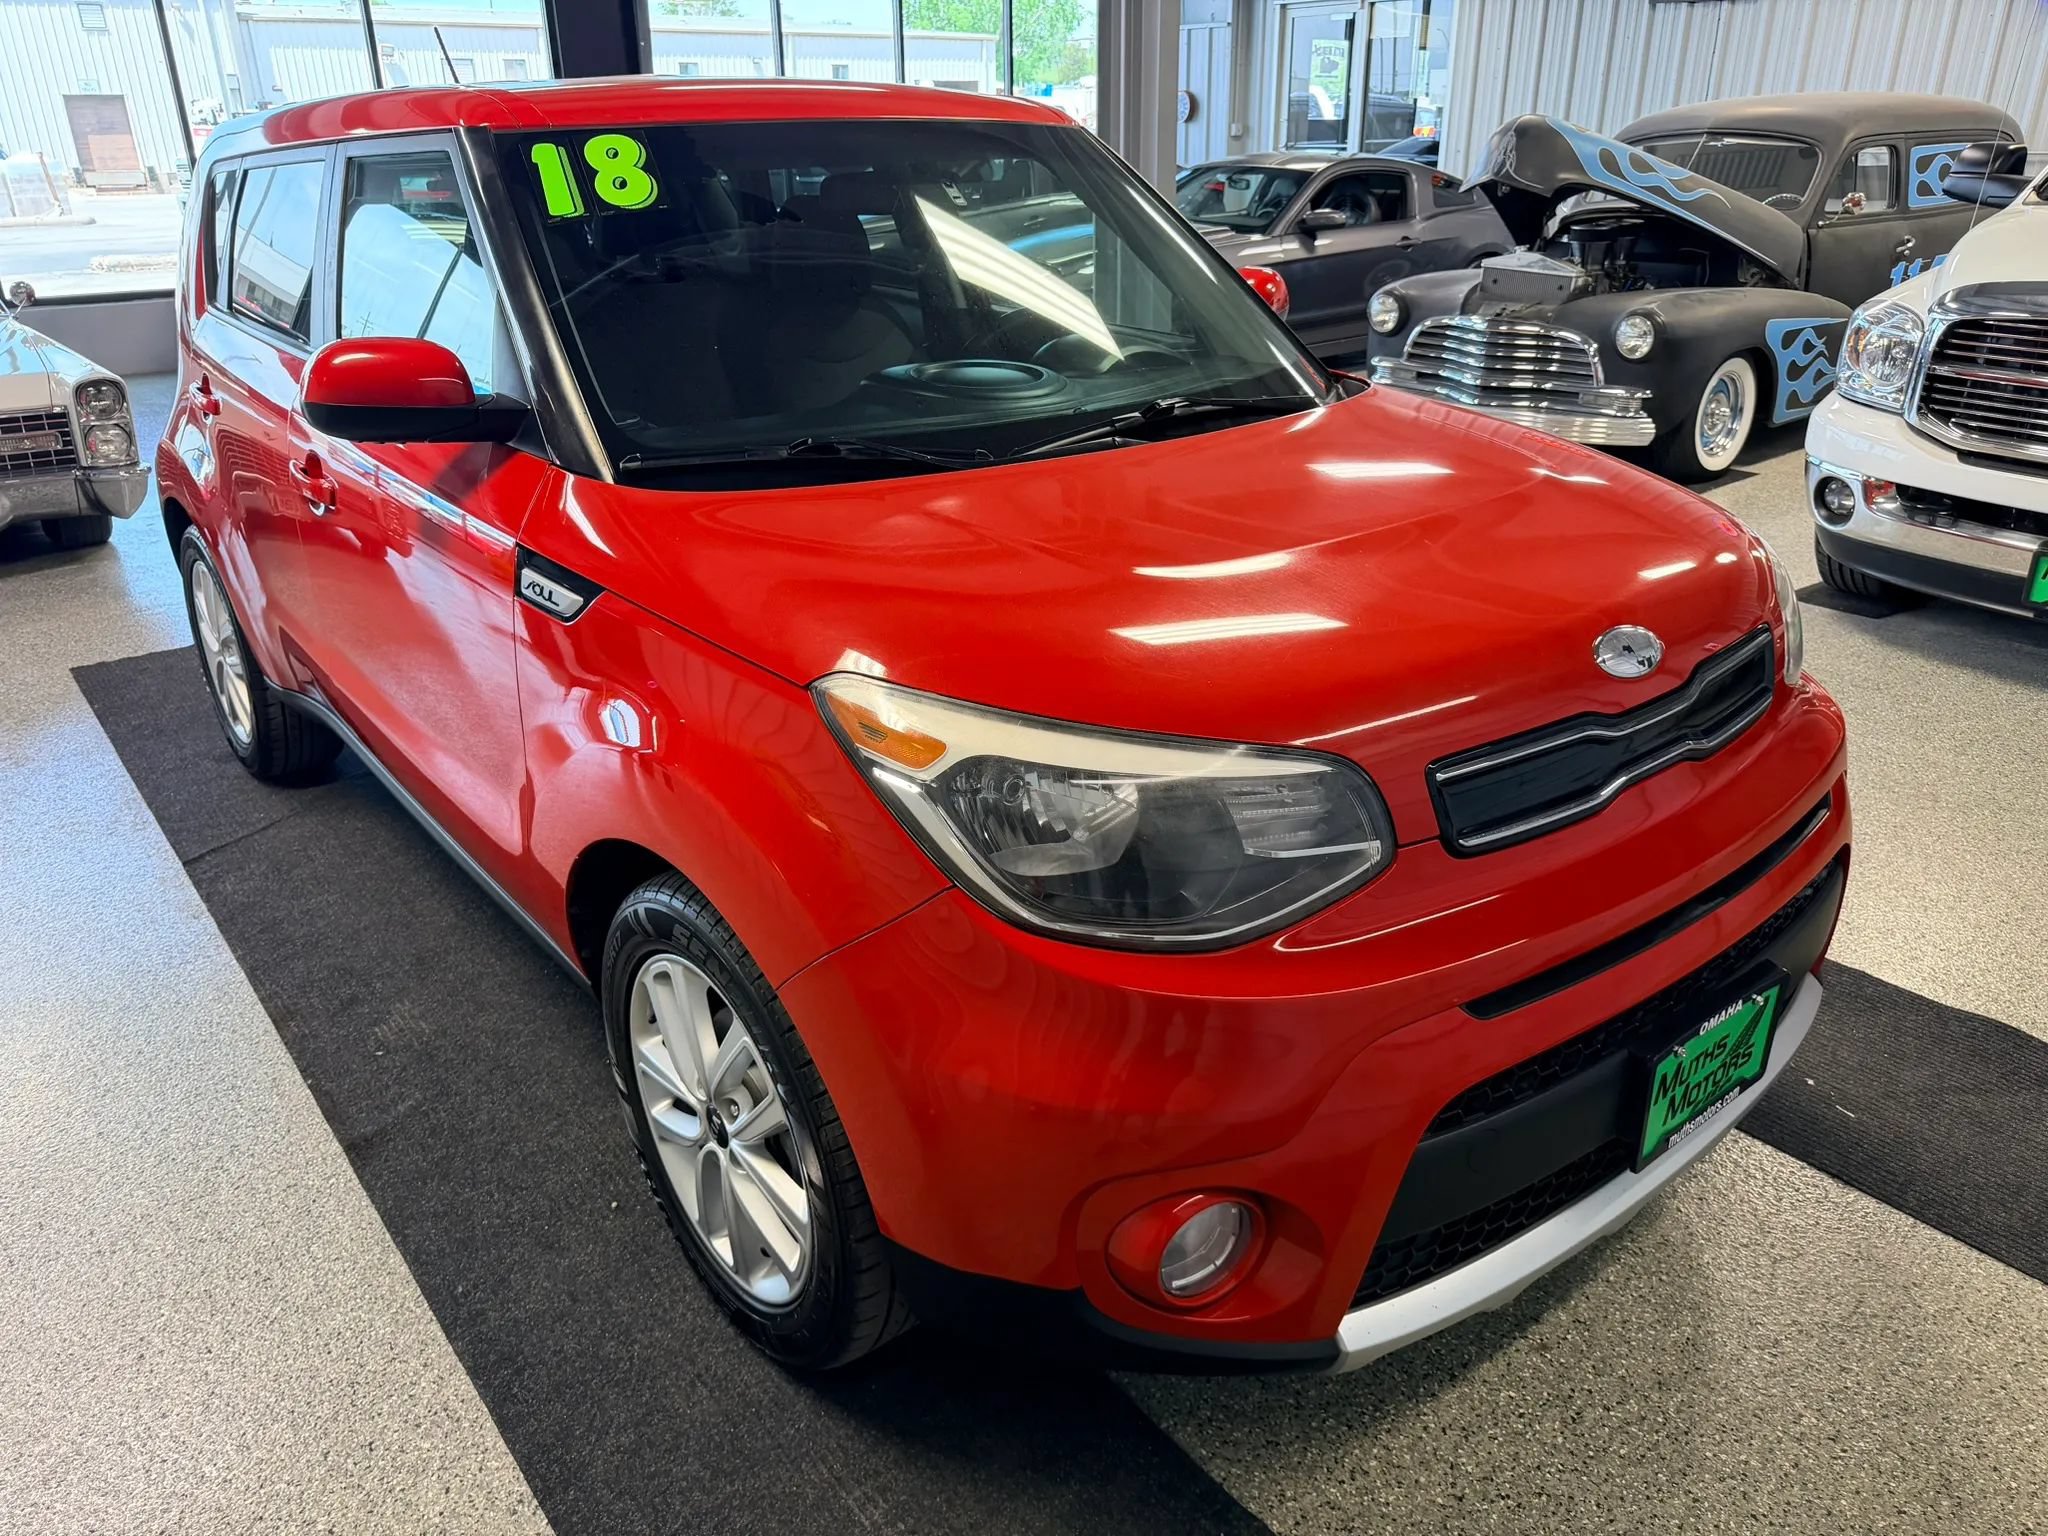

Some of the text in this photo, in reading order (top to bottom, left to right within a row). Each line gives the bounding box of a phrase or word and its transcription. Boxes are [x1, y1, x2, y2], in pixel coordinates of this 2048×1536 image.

[531, 133, 658, 218] 18
[523, 580, 560, 607] SOUL
[1699, 999, 1744, 1035] OMAHA
[1653, 1033, 1731, 1106] MUTHS
[1662, 1041, 1756, 1126] MOTORS
[1668, 1086, 1741, 1149] muthsmotors.com
